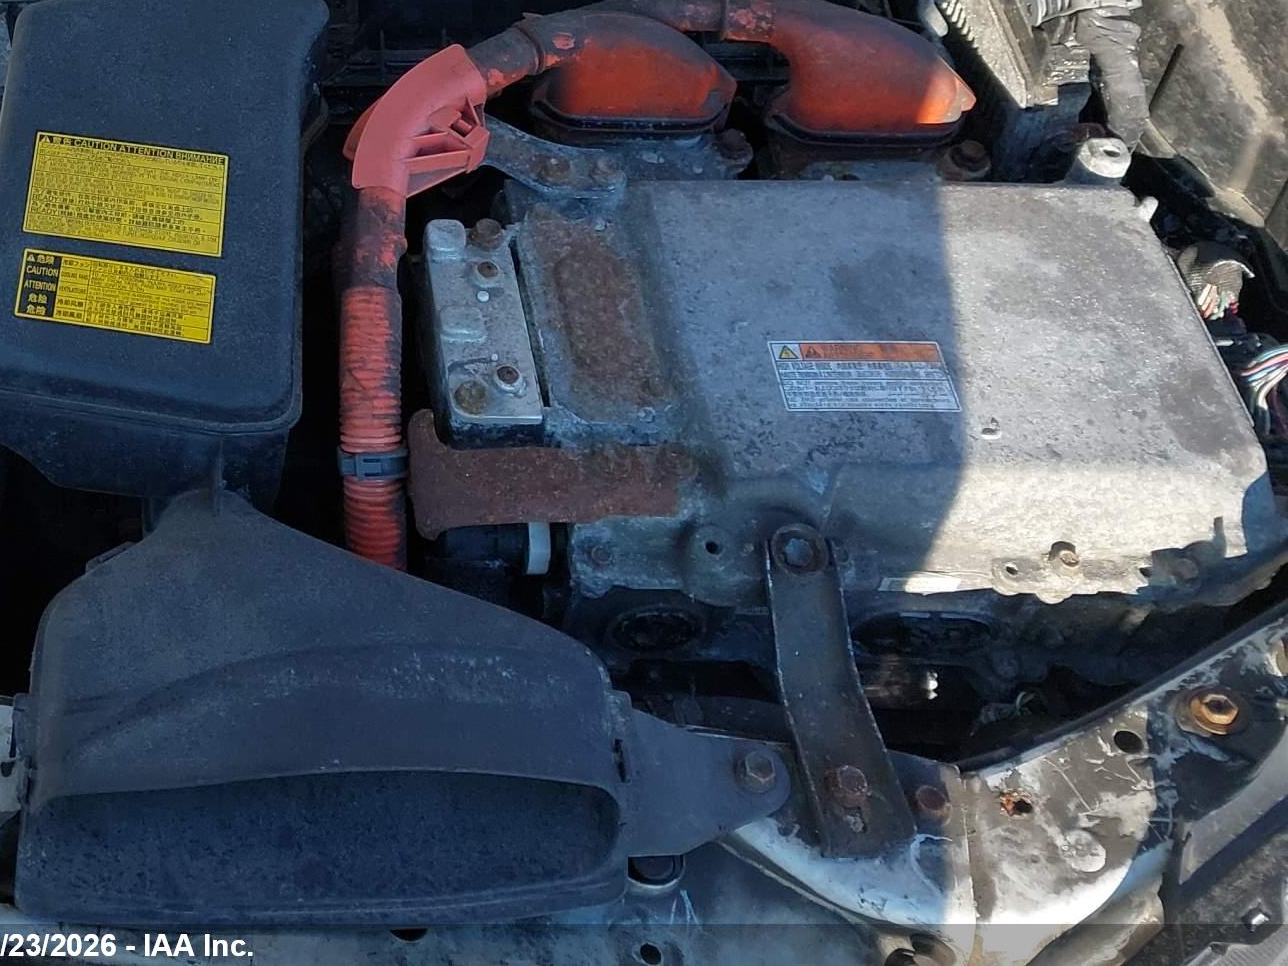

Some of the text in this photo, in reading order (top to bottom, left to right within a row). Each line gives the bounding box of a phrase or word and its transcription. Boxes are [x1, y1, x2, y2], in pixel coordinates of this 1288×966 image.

[74, 138, 117, 151] CAUTION
[119, 144, 174, 158] ATTENTION
[175, 152, 224, 165] ВНИМАНИЕ
[26, 265, 59, 277] CAUTION
[24, 279, 57, 292] ATTENTION
